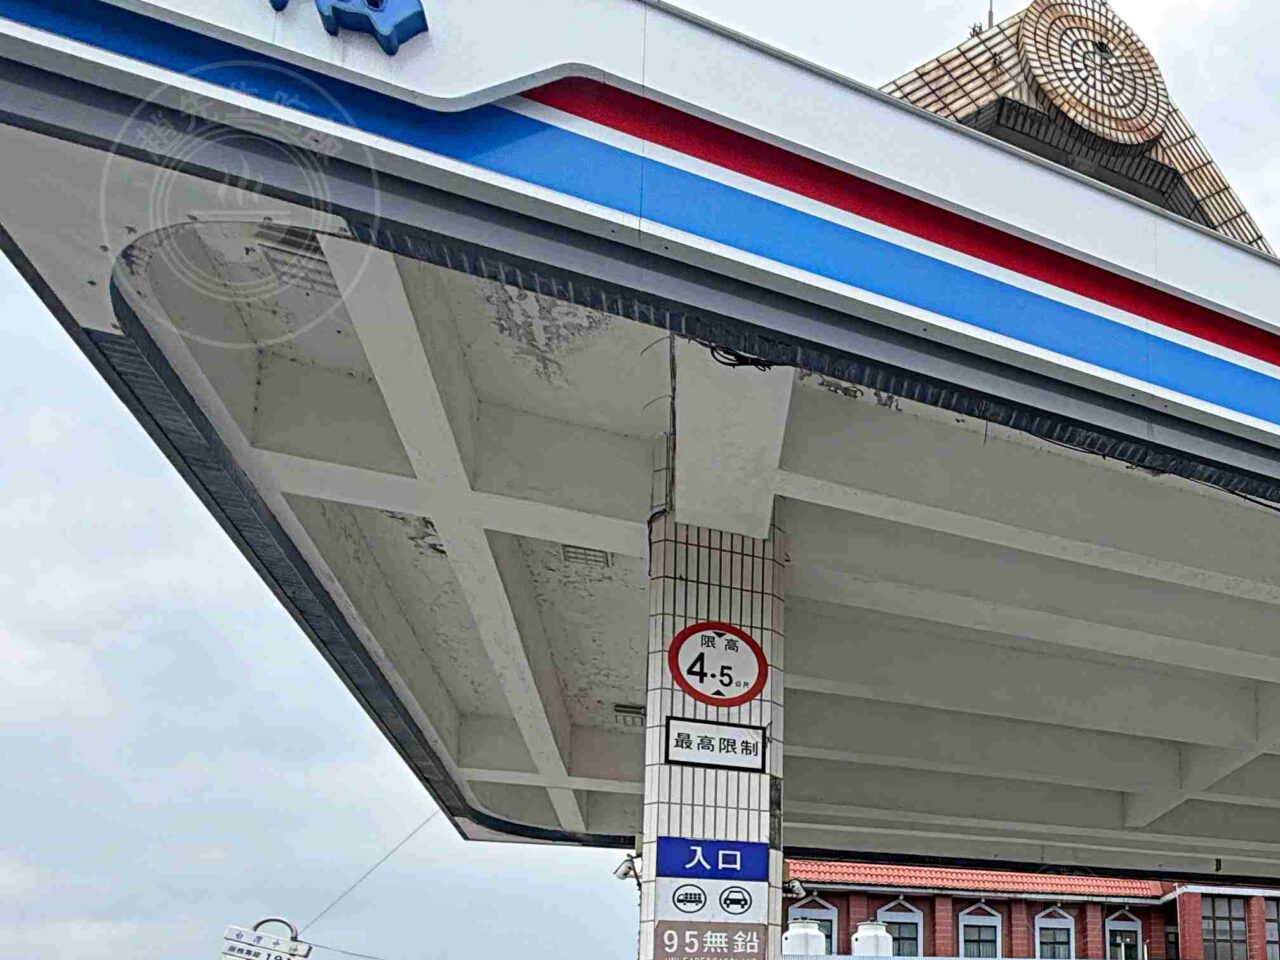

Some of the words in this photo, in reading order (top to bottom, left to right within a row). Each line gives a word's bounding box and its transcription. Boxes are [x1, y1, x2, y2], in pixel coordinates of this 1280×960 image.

[700, 634, 739, 653] 限高
[686, 652, 733, 687] 4.5
[734, 680, 750, 689] 公尺
[673, 732, 759, 757] 最高限制
[684, 845, 741, 871] 入口
[663, 929, 760, 954] 95無鉛
